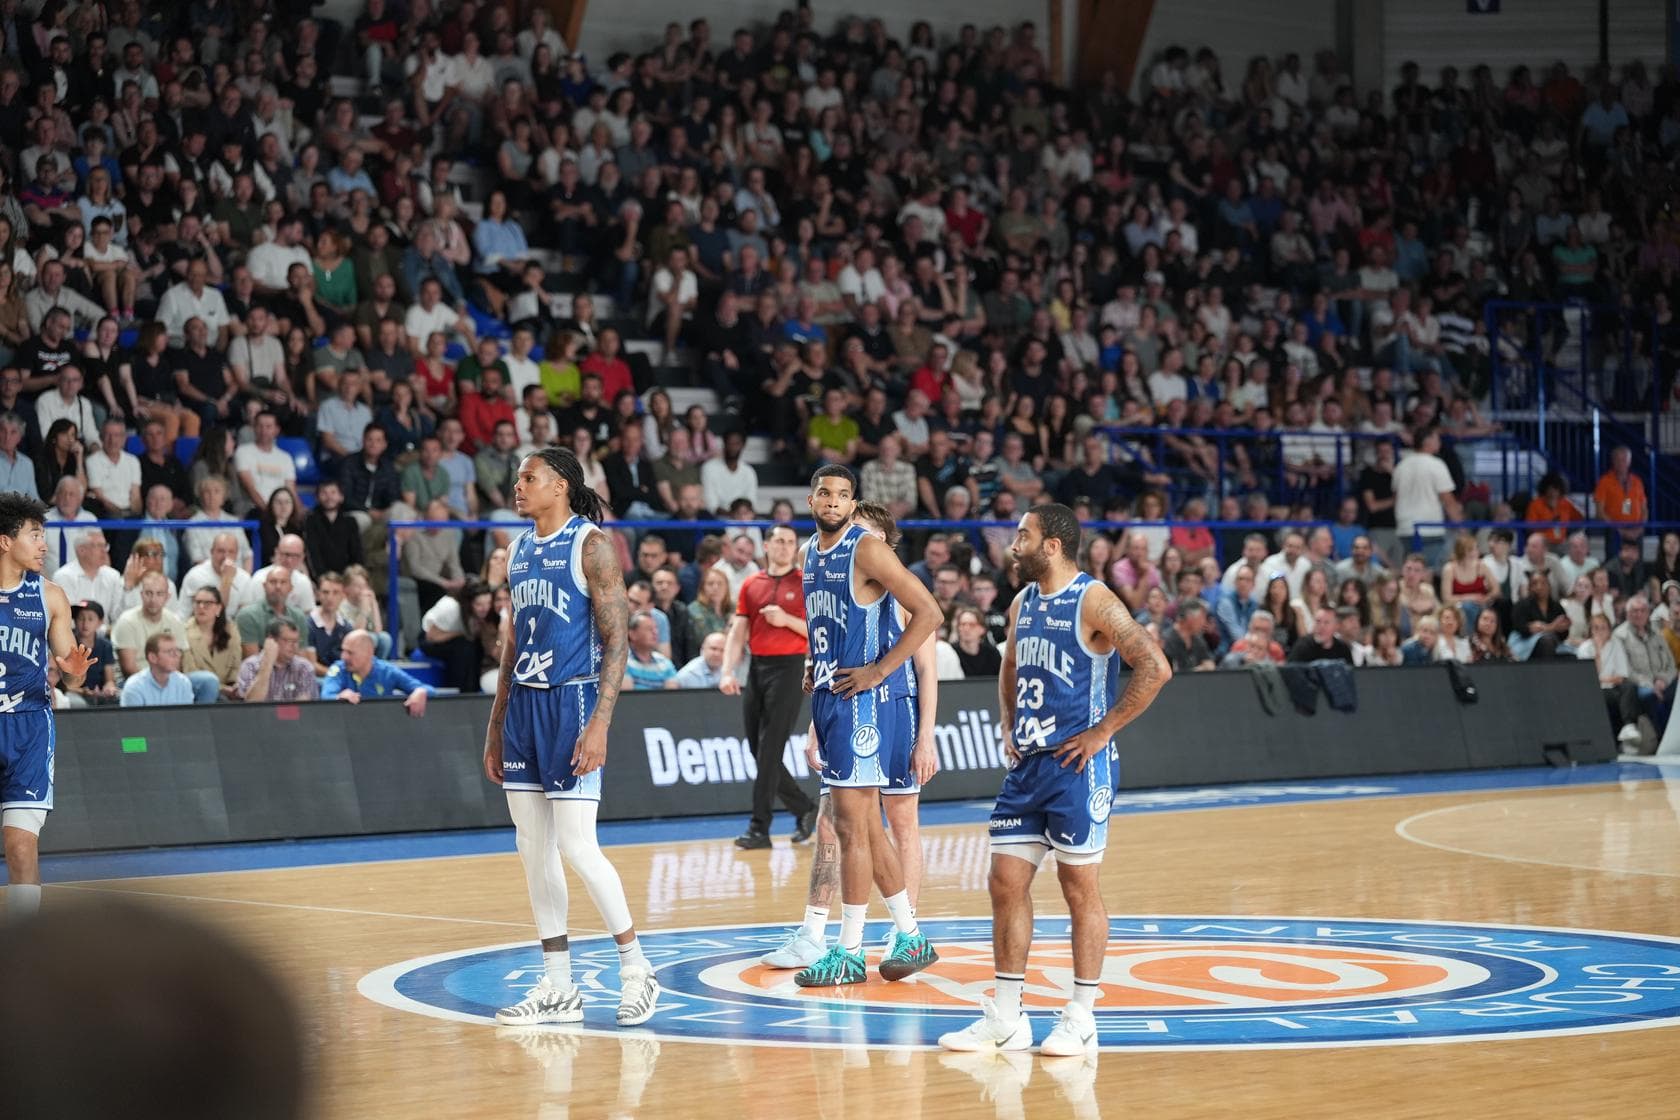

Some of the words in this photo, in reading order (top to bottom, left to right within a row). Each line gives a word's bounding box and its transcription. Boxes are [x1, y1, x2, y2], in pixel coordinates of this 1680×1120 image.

[14, 607, 43, 618] Roanne
[511, 578, 571, 624] HORALE
[806, 589, 848, 634] HORALE
[526, 616, 537, 646] 1
[1016, 636, 1075, 689] ORALE
[1017, 677, 1045, 710] 23
